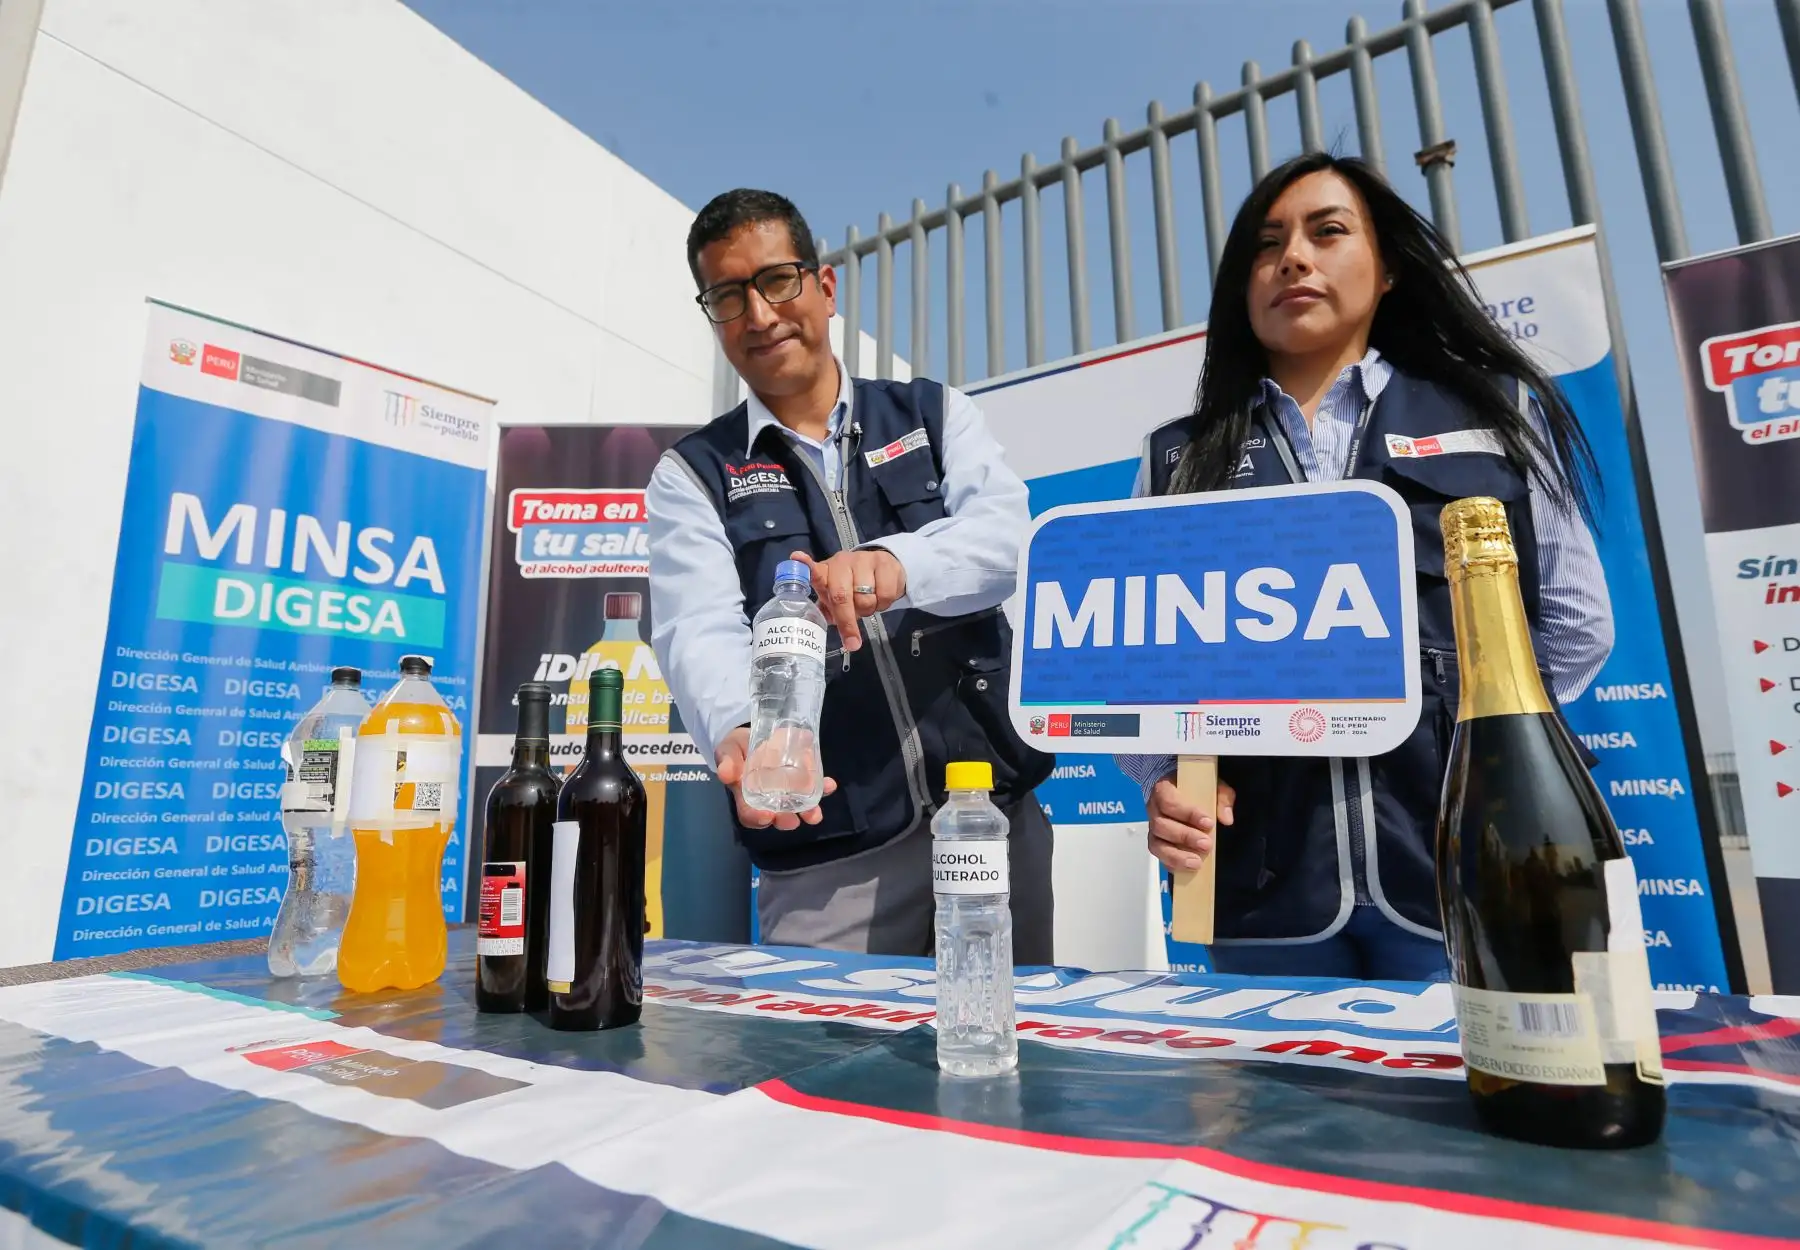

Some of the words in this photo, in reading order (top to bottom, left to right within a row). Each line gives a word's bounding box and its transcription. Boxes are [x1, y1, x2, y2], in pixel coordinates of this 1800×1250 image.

[421, 405, 480, 431] Siempre
[441, 425, 479, 442] pueblo
[1751, 424, 1771, 439] el
[730, 472, 790, 488] DIGESA
[522, 500, 598, 520] Toma
[604, 503, 638, 519] en
[164, 492, 446, 594] MINSA
[533, 528, 577, 556] tu
[581, 526, 650, 556] salu
[525, 564, 538, 574] el
[539, 564, 587, 574] alcohol
[589, 564, 649, 574] adultera
[213, 577, 405, 637] DIGESA
[1032, 563, 1390, 649] MINSA
[767, 625, 816, 640] ALCOHOL
[117, 646, 178, 662] Dirección
[183, 653, 233, 666] General
[236, 657, 251, 667] de
[254, 658, 285, 671] Salud
[111, 671, 198, 693] DIGESA
[224, 678, 300, 699] DIGESA
[1595, 683, 1667, 702] MINSA
[108, 701, 171, 715] Dirección
[175, 705, 226, 717] General
[229, 707, 245, 718] de
[248, 708, 281, 720] Salud
[1074, 720, 1106, 728] Ministerio
[1206, 715, 1260, 729] Siempre
[103, 725, 191, 745] DIGESA
[1225, 728, 1260, 738] pueblo
[100, 756, 164, 768] Dirección
[168, 757, 220, 769] General
[223, 758, 240, 769] de
[243, 759, 275, 770] Salud
[650, 770, 710, 781] saludable.
[1051, 765, 1096, 779] MINSA
[94, 782, 185, 799] DIGESA
[1610, 778, 1685, 796] MINSA
[1078, 801, 1125, 815] MINSA
[91, 812, 157, 824] Dirección
[161, 812, 214, 823] General
[218, 811, 234, 822] de
[237, 811, 270, 822] Salud
[85, 837, 178, 856] DIGESA
[206, 834, 286, 853] DIGESA
[82, 869, 150, 881] Dirección
[154, 867, 208, 879] General
[211, 866, 228, 876] de
[231, 864, 265, 876] Salud
[933, 870, 999, 881] ULTERADO
[76, 893, 171, 915] DIGESA
[199, 887, 281, 908] DIGESA
[73, 926, 142, 942] Dirección
[147, 923, 201, 936] General
[205, 920, 222, 932] de
[225, 917, 259, 930] Salud
